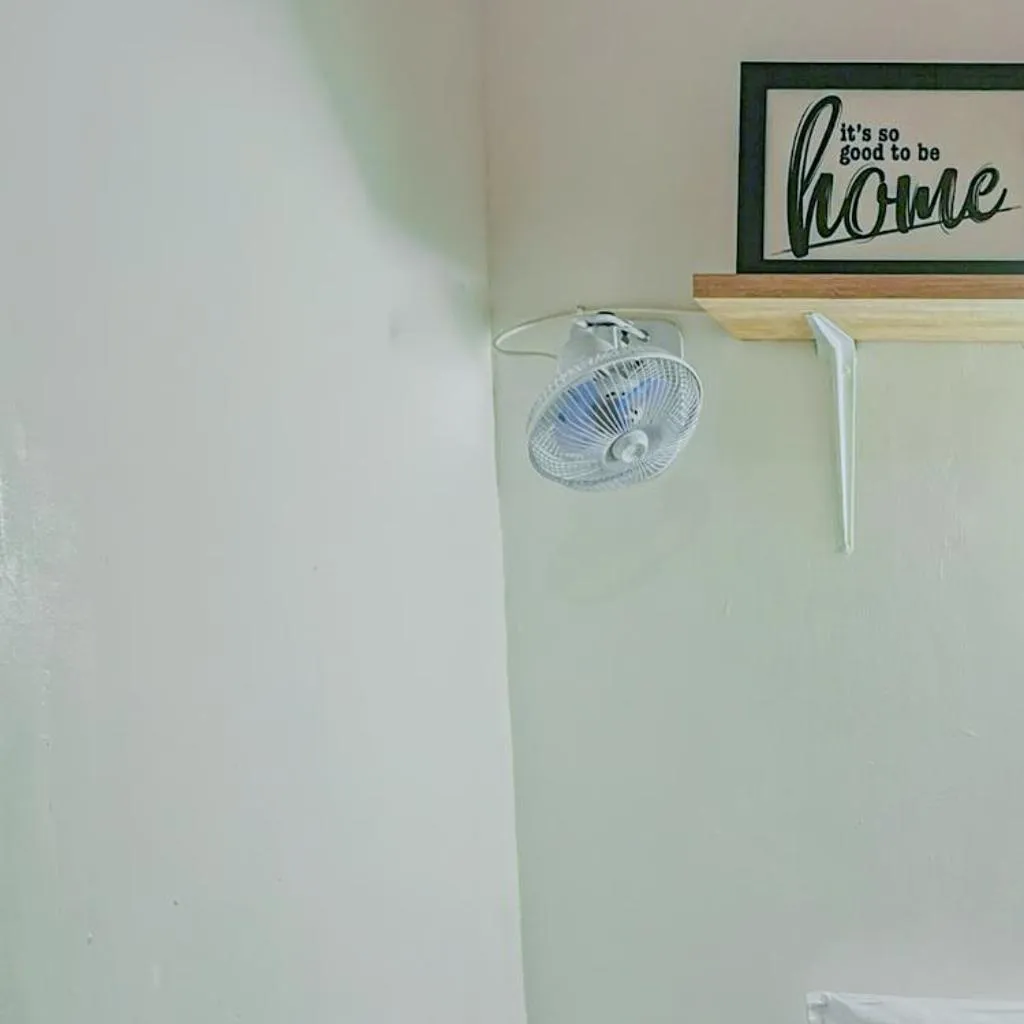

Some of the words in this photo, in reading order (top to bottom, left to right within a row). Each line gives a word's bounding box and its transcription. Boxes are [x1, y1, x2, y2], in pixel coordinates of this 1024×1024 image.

[840, 123, 872, 142] it's
[878, 126, 900, 142] so
[839, 143, 885, 166] good
[891, 145, 911, 162] to
[917, 143, 941, 162] be
[787, 95, 1008, 258] home
